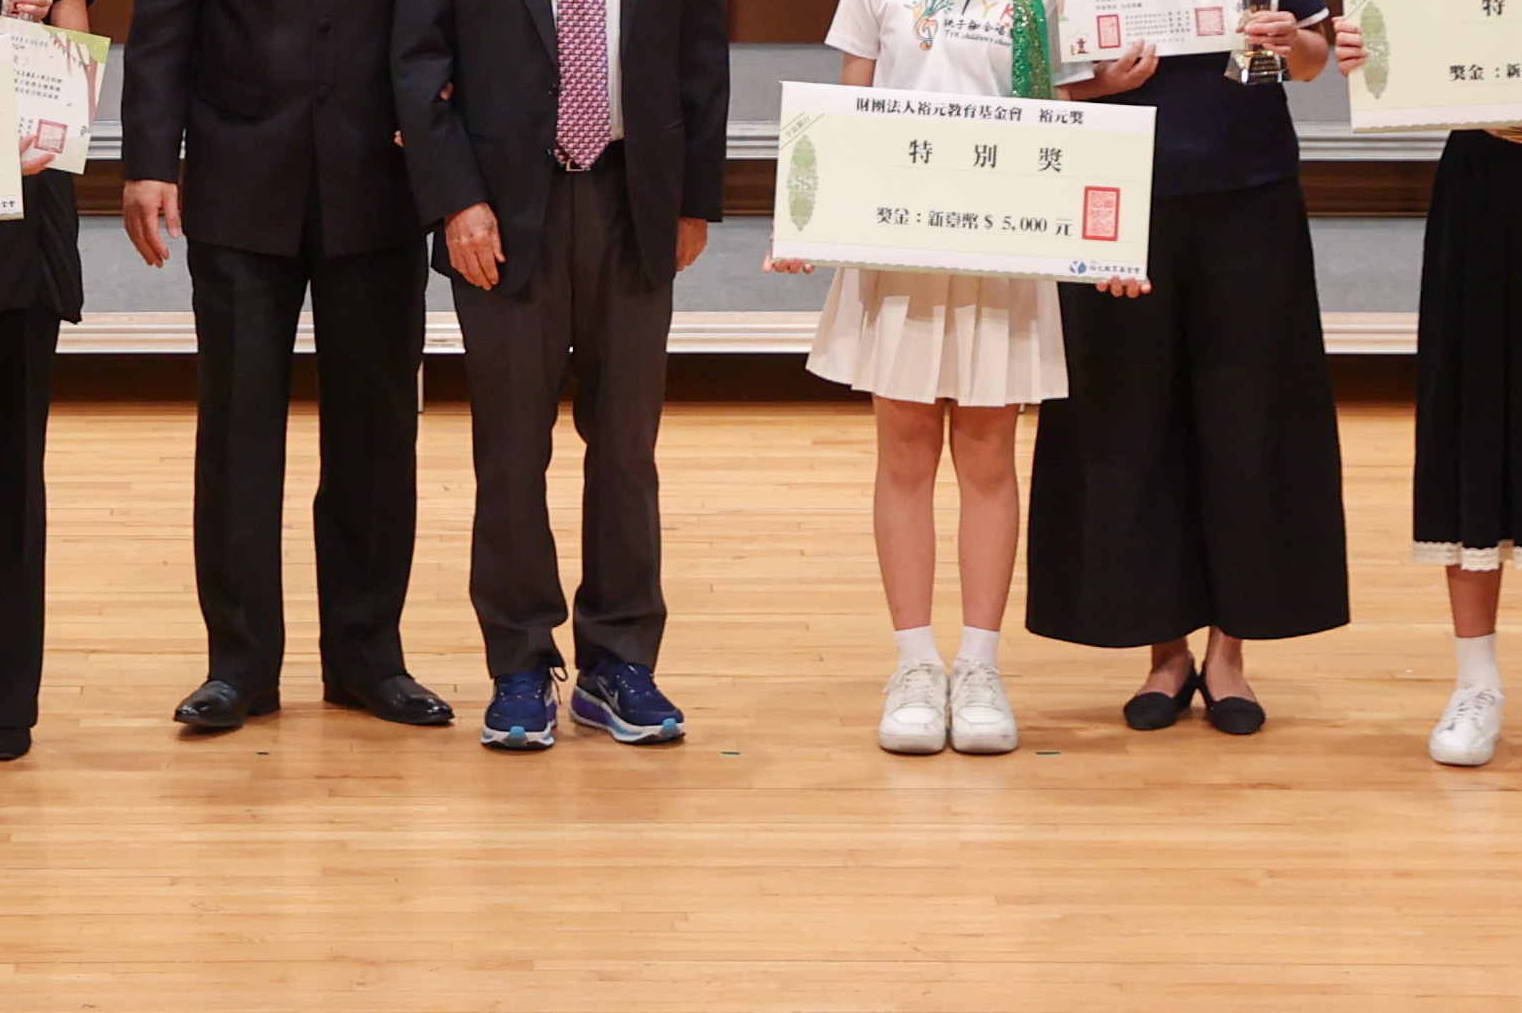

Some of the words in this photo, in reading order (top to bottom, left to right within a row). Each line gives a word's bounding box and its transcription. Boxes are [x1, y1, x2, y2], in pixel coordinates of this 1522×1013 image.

[856, 97, 1022, 121] 財團法人裕元教育基金會
[1039, 108, 1084, 125] 裕元獎
[1002, 215, 1048, 234] 5,000
[1055, 218, 1073, 237] 元
